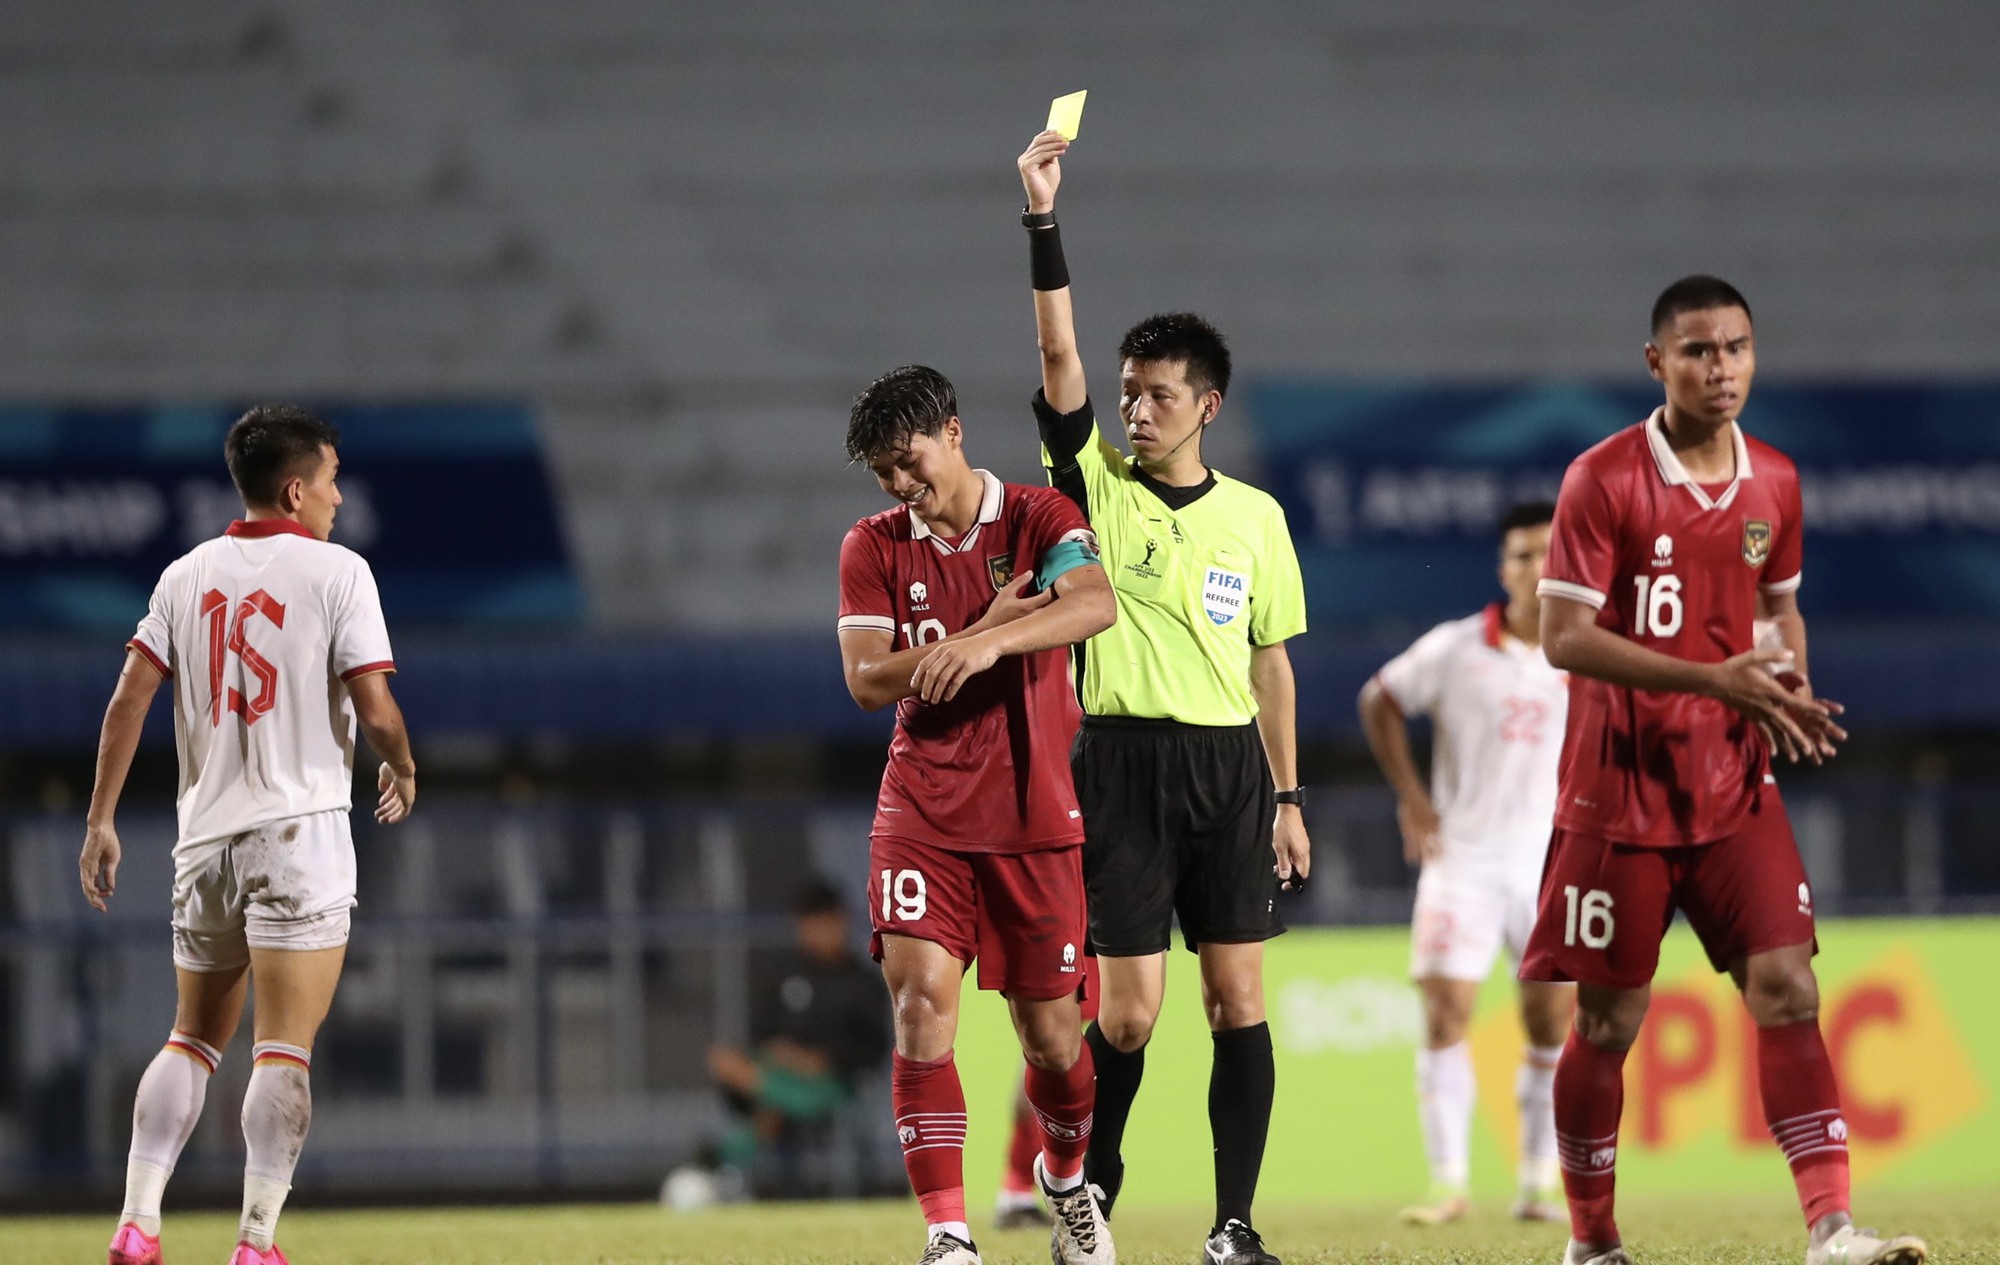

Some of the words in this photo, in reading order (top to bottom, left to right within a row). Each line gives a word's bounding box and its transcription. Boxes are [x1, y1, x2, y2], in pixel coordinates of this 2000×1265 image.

[1205, 592, 1240, 607] REFEREE
[1208, 571, 1242, 591] FIFA
[1633, 574, 1683, 638] 16
[911, 603, 930, 612] MILLS
[1211, 612, 1228, 622] 2023
[201, 588, 286, 729] 15
[1498, 695, 1549, 746] 22
[881, 868, 927, 922] 19
[1564, 885, 1615, 949] 16
